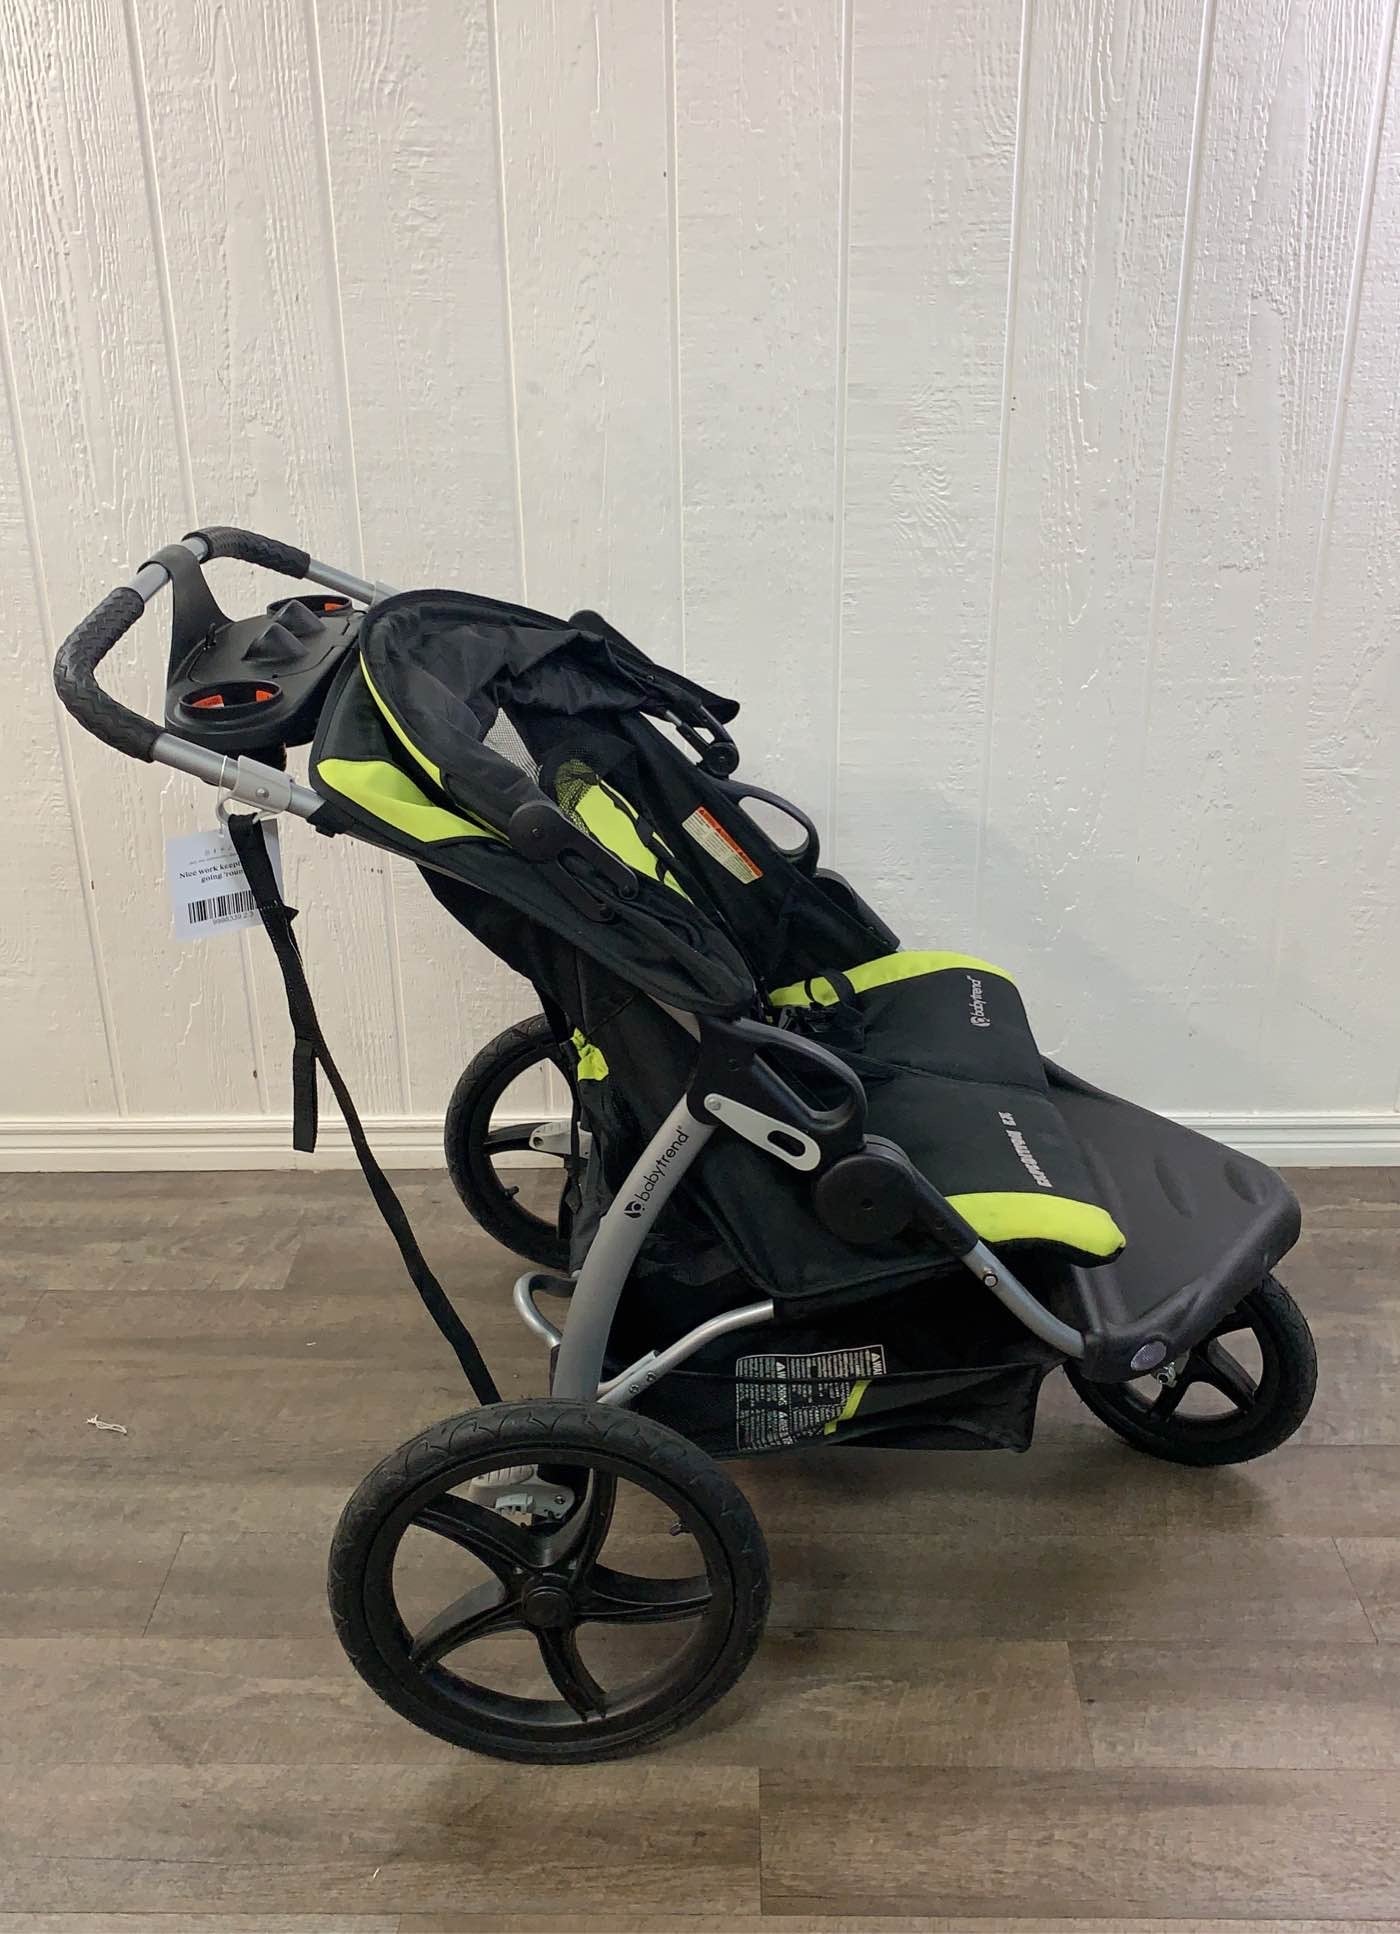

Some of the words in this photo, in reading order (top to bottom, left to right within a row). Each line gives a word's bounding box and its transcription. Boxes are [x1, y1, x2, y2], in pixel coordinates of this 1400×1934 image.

[179, 870, 197, 879] Nice
[199, 866, 218, 875] work
[219, 861, 241, 871] keepi
[201, 873, 222, 883] going
[224, 869, 244, 877] 'roun
[967, 975, 987, 1016] babytrend
[634, 1128, 690, 1201] babytrend
